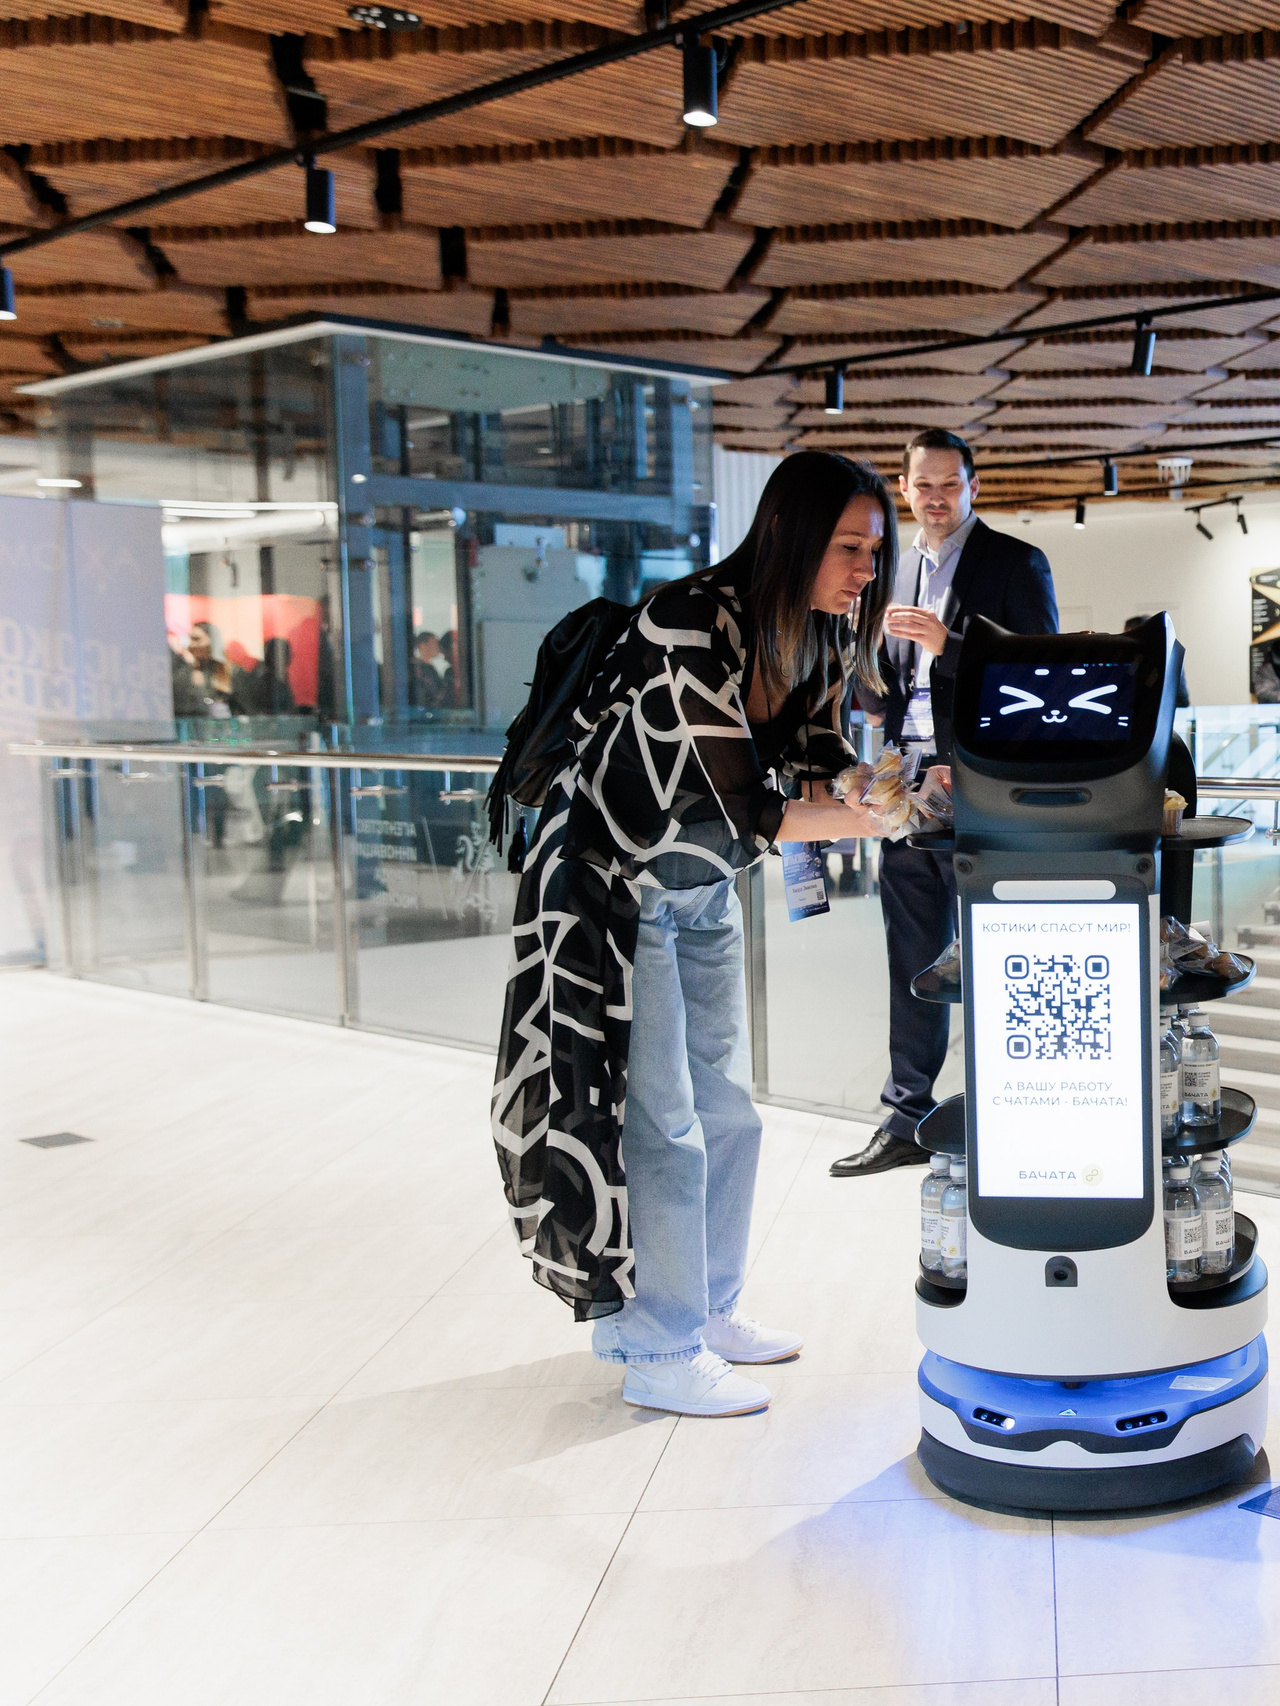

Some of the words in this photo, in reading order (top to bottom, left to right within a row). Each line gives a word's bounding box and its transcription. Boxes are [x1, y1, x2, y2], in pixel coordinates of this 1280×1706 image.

[982, 922, 1037, 933] КОТИКИ
[1040, 922, 1094, 933] СПАСУТ
[1097, 922, 1131, 933] МИР!
[1003, 1081, 1013, 1091] А
[1017, 1081, 1057, 1091] ВАШУ
[1060, 1081, 1113, 1092] РАБОТУ
[992, 1096, 1001, 1106] С
[1004, 1096, 1060, 1106] ЧАТАМИ
[1072, 1096, 1128, 1107] БАЧАТА!
[1018, 1170, 1077, 1180] БАЧАТА
